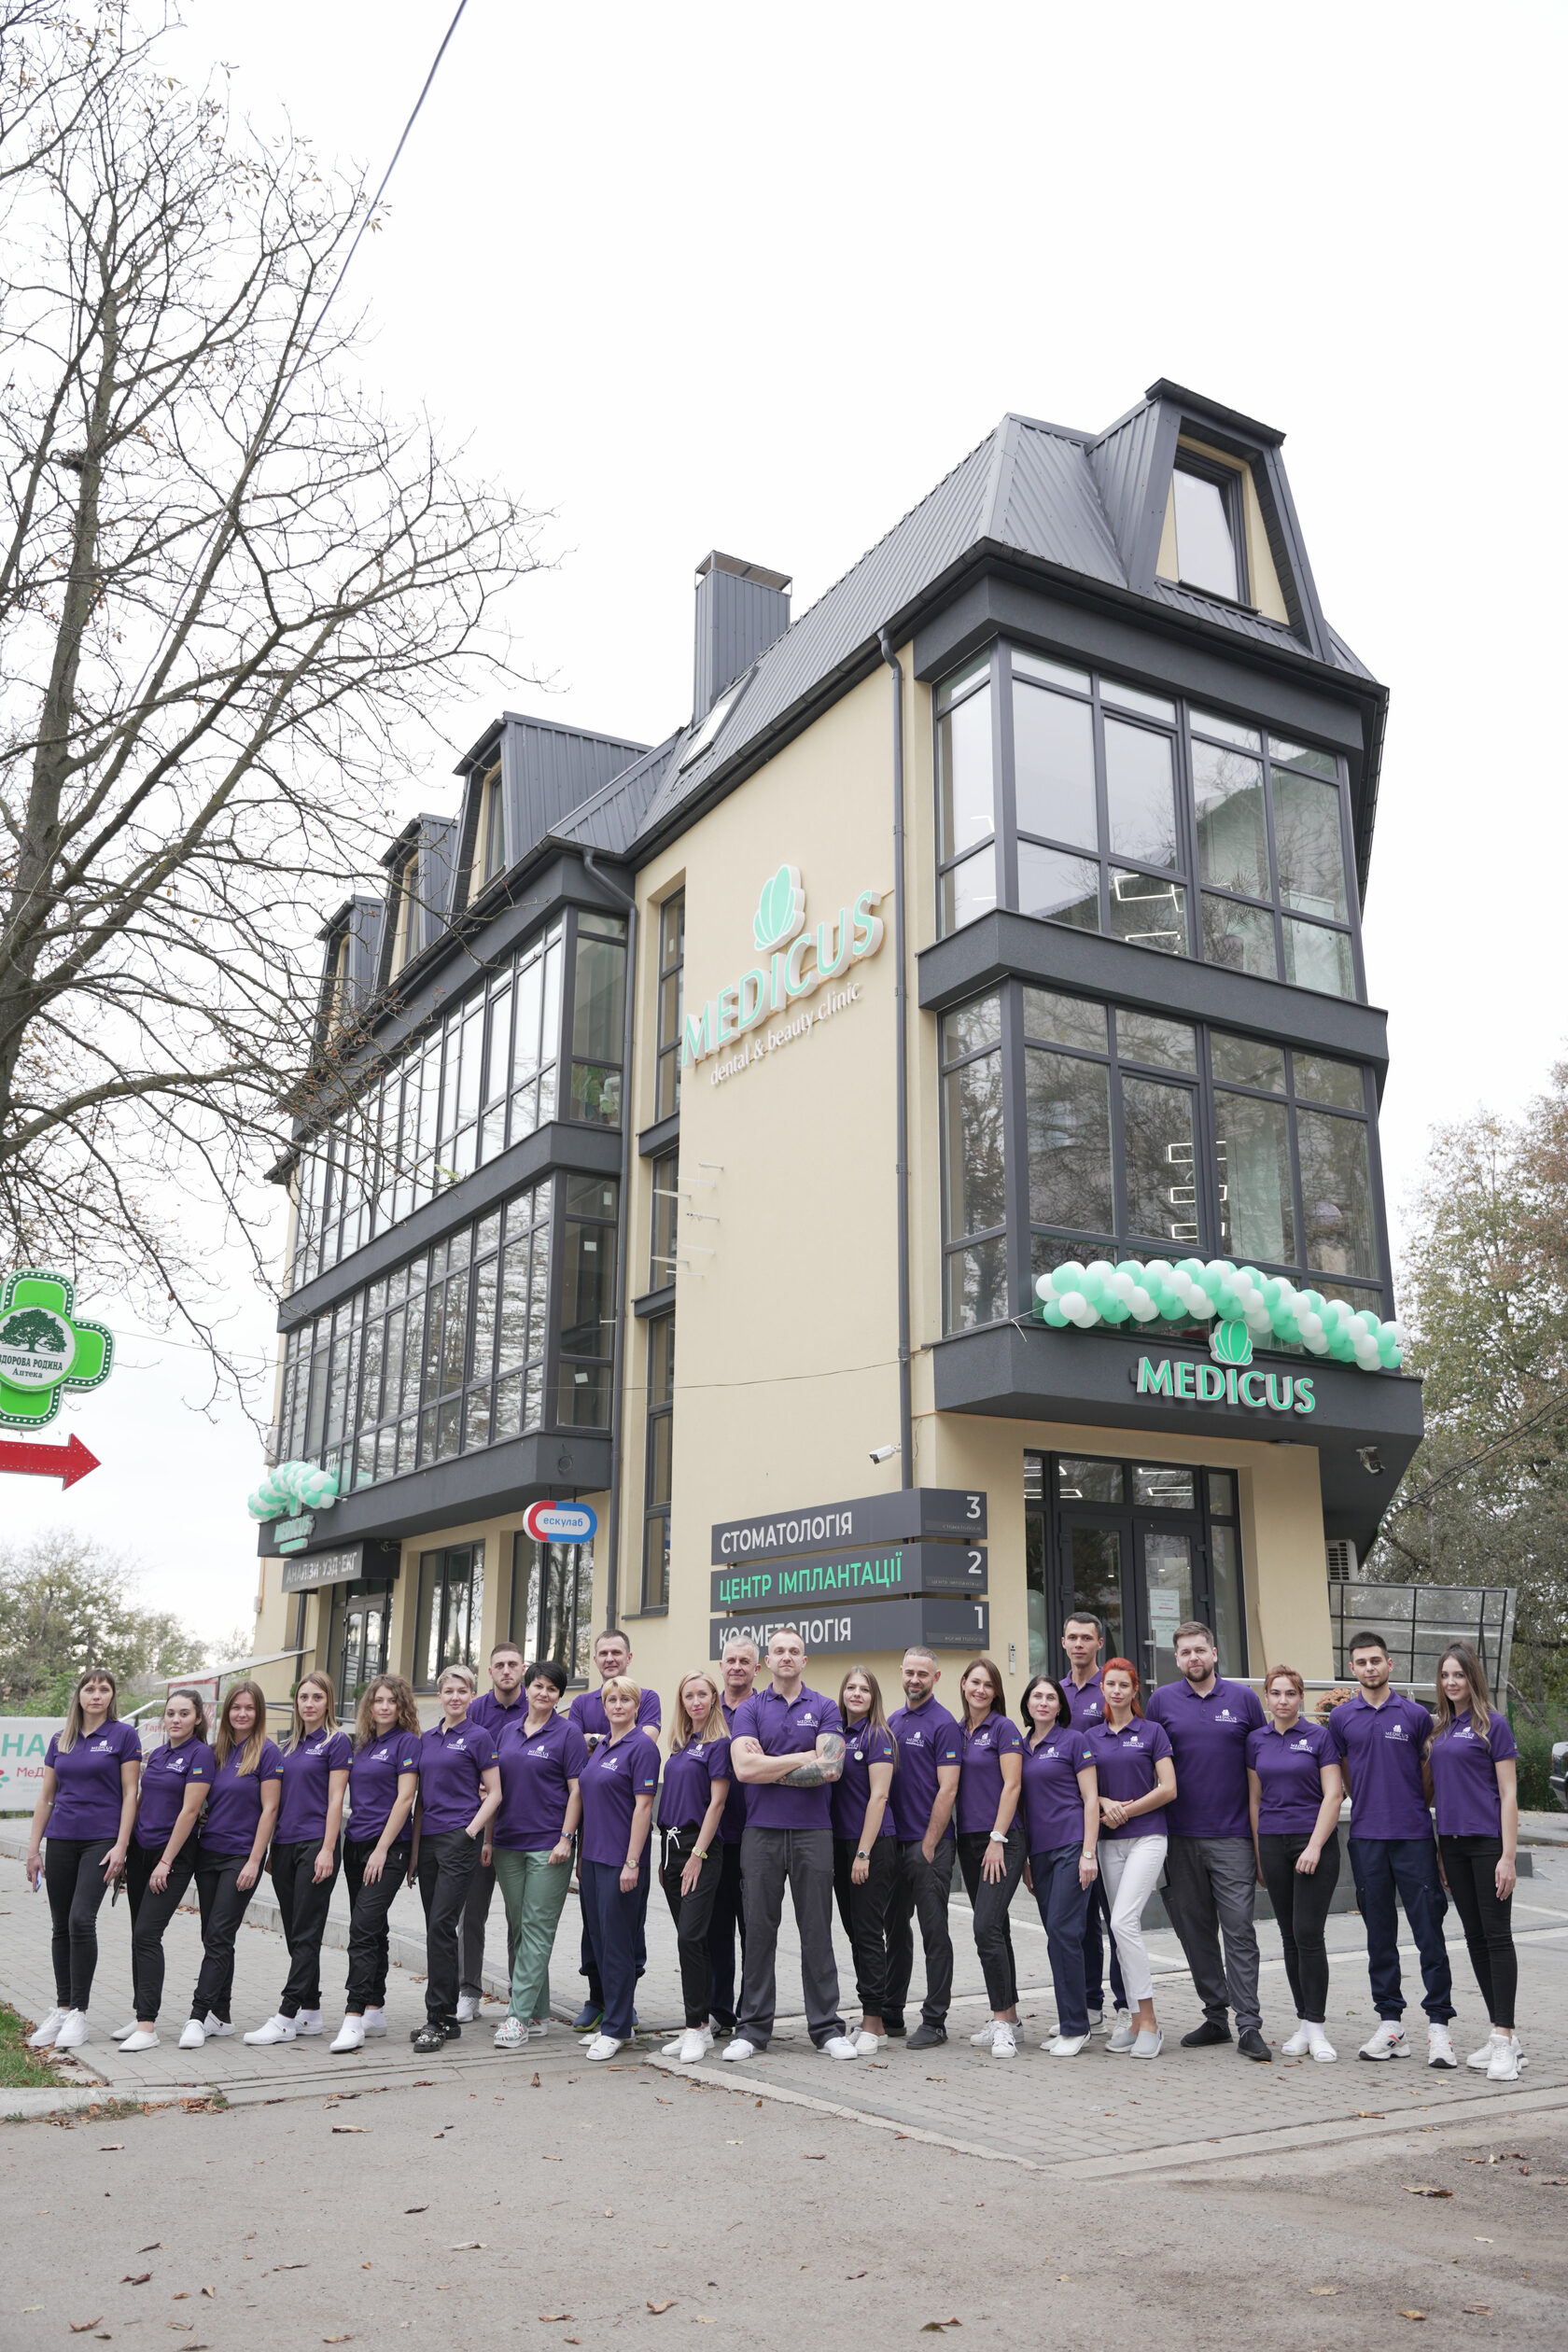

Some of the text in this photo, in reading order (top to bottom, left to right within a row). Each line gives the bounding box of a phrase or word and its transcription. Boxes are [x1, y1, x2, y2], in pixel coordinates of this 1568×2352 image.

[682, 889, 884, 1068] MEDICUS
[710, 982, 861, 1086] dental & beauty clinic
[12, 1367, 43, 1379] Аптека
[33, 1358, 63, 1371] РОДИНА
[1136, 1356, 1316, 1414] MEDICUS
[966, 1495, 981, 1519] 3
[543, 1517, 583, 1528] ескулаб
[721, 1510, 852, 1554] СТОМАТОЛОГІЯ
[322, 1556, 339, 1577] УЗД
[341, 1551, 357, 1573] ЕКГ
[968, 1551, 982, 1574] 2
[720, 1551, 903, 1604] ЦЕНТР ІМПЛАНТАЦІЇ
[973, 1605, 984, 1630] 1
